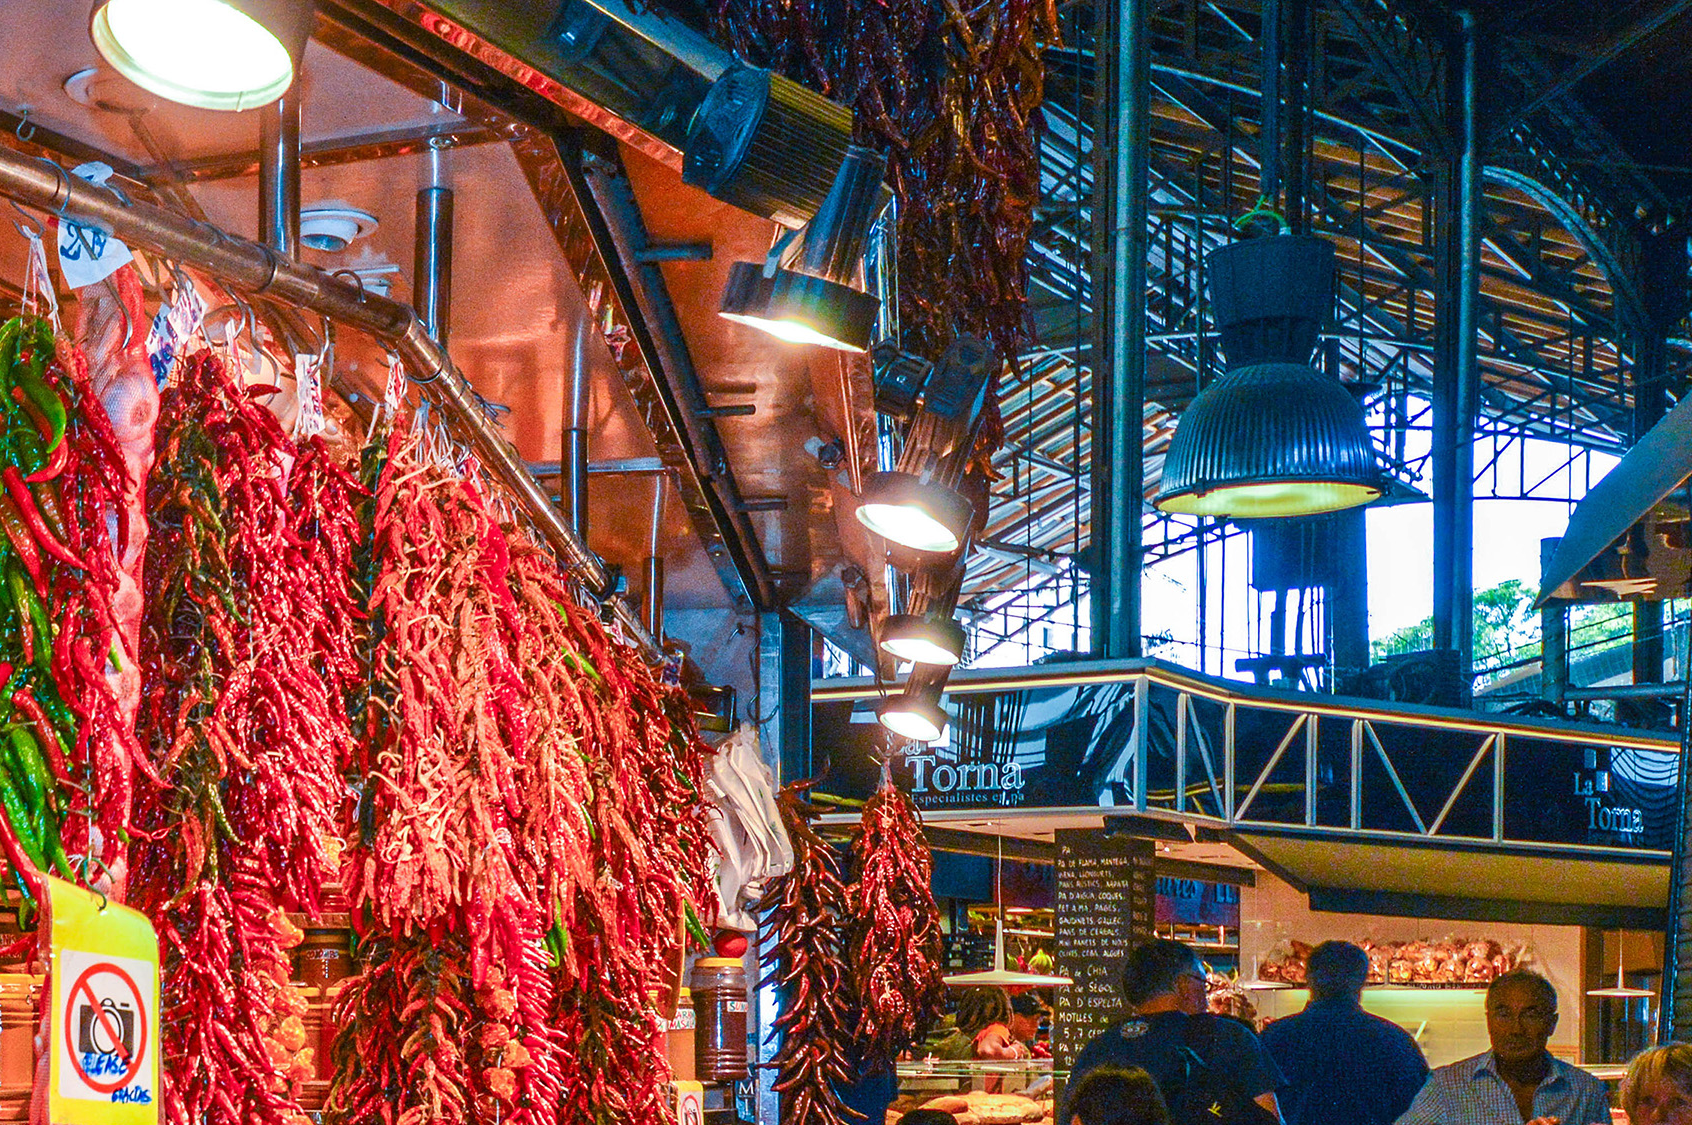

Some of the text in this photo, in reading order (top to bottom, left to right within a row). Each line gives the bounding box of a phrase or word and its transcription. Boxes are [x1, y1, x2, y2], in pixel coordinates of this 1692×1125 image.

[904, 754, 1026, 793] Torna
[1573, 771, 1594, 796] La
[910, 791, 989, 807] Especialistes
[1584, 797, 1645, 833] Torna
[1059, 996, 1071, 1008] PA
